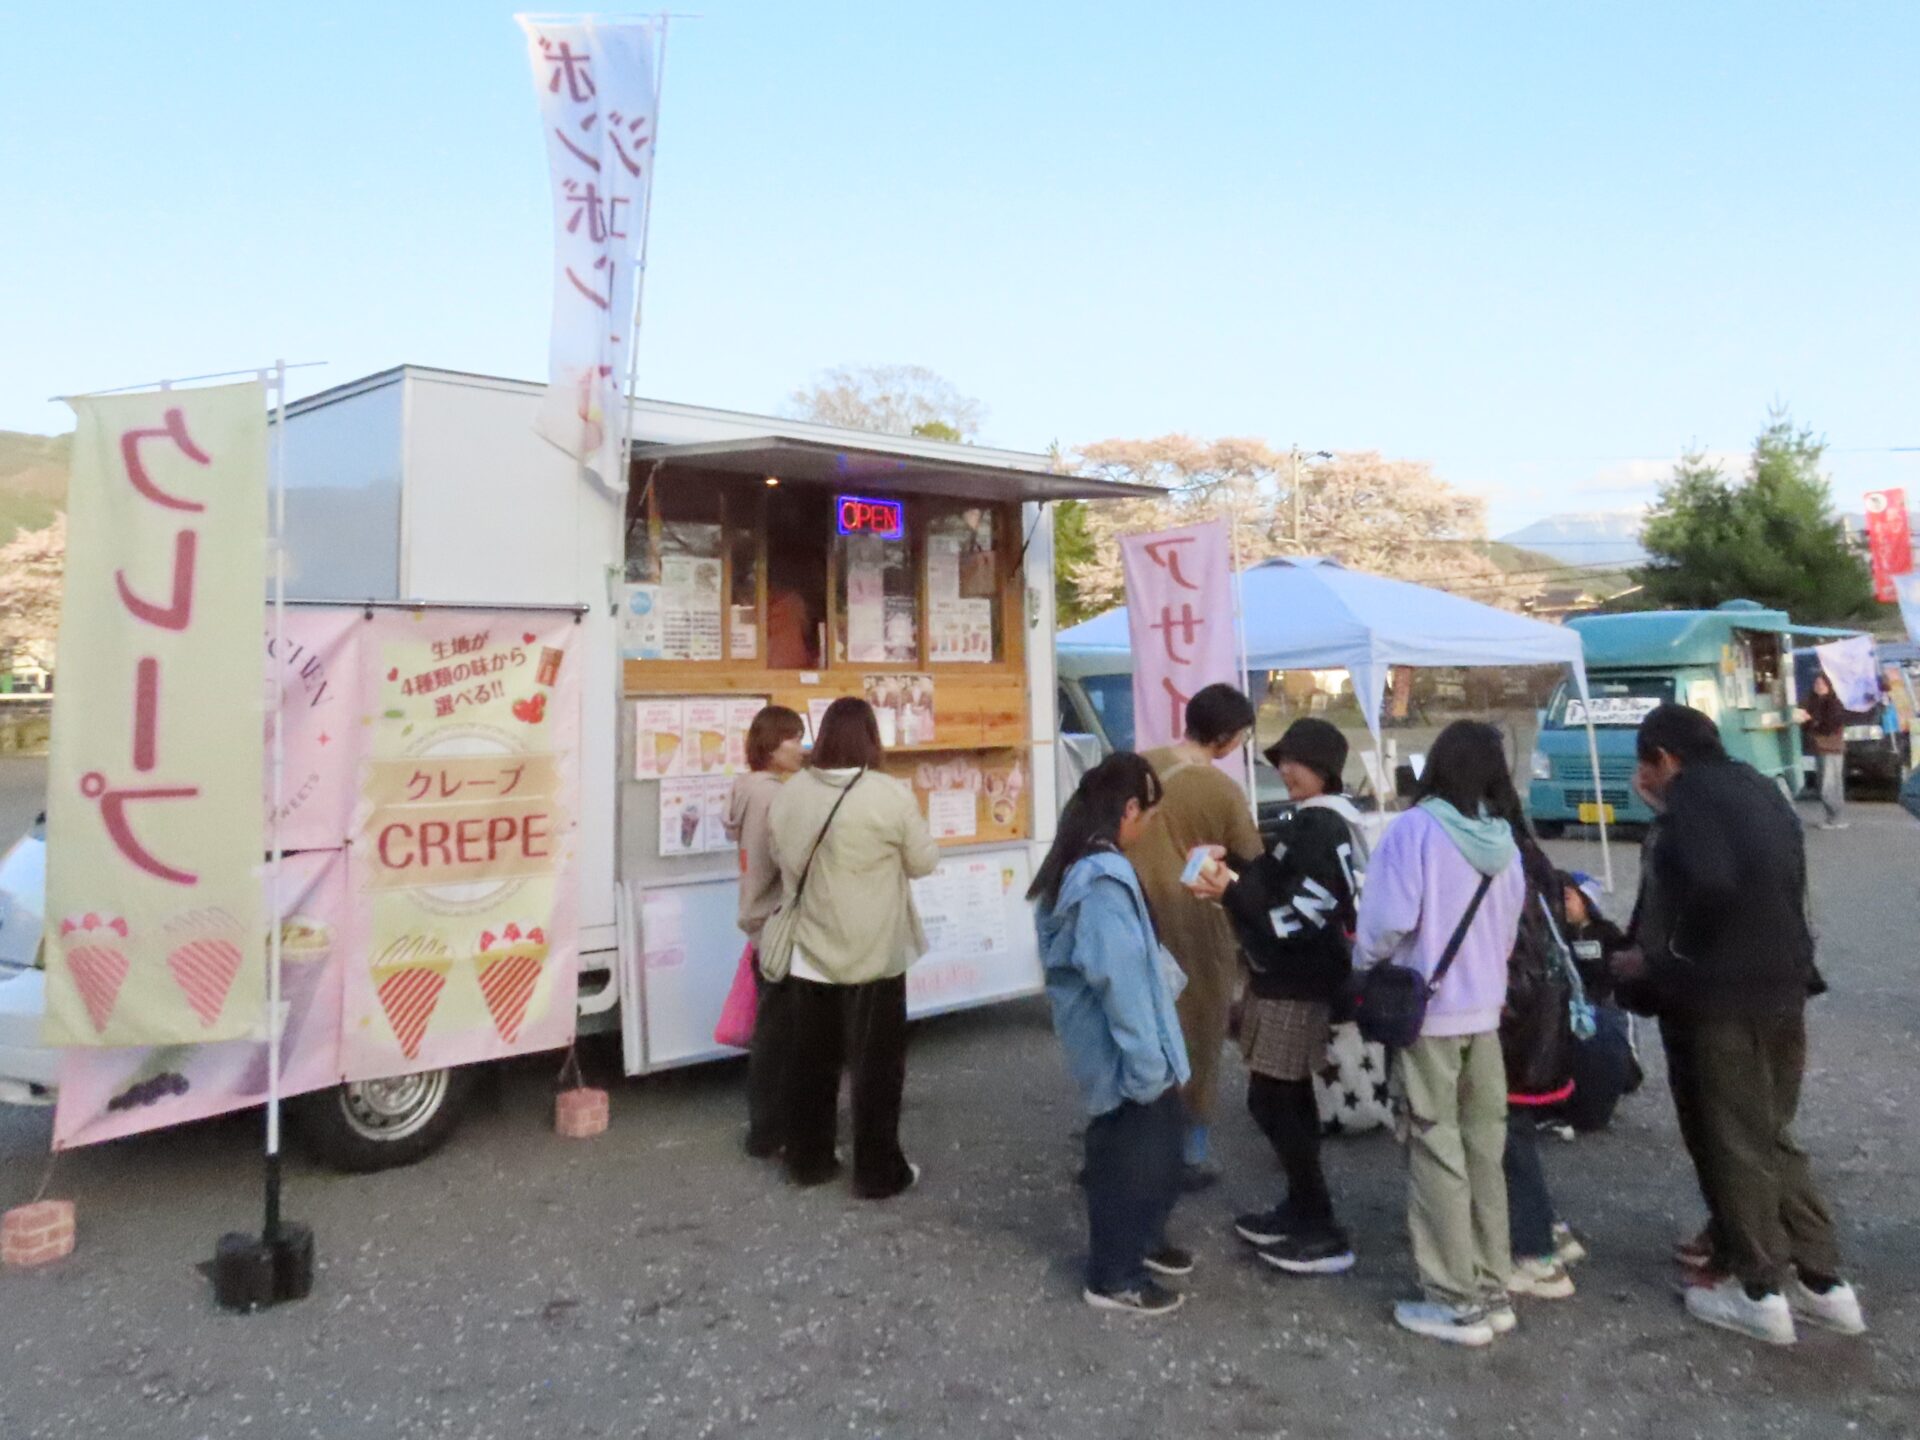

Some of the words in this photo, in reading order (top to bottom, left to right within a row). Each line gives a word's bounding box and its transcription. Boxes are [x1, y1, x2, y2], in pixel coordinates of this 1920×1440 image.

[842, 502, 897, 531] OPEN
[432, 630, 490, 662] 生地が
[401, 647, 527, 697] 4種類の味から
[378, 814, 548, 869] CREPE
